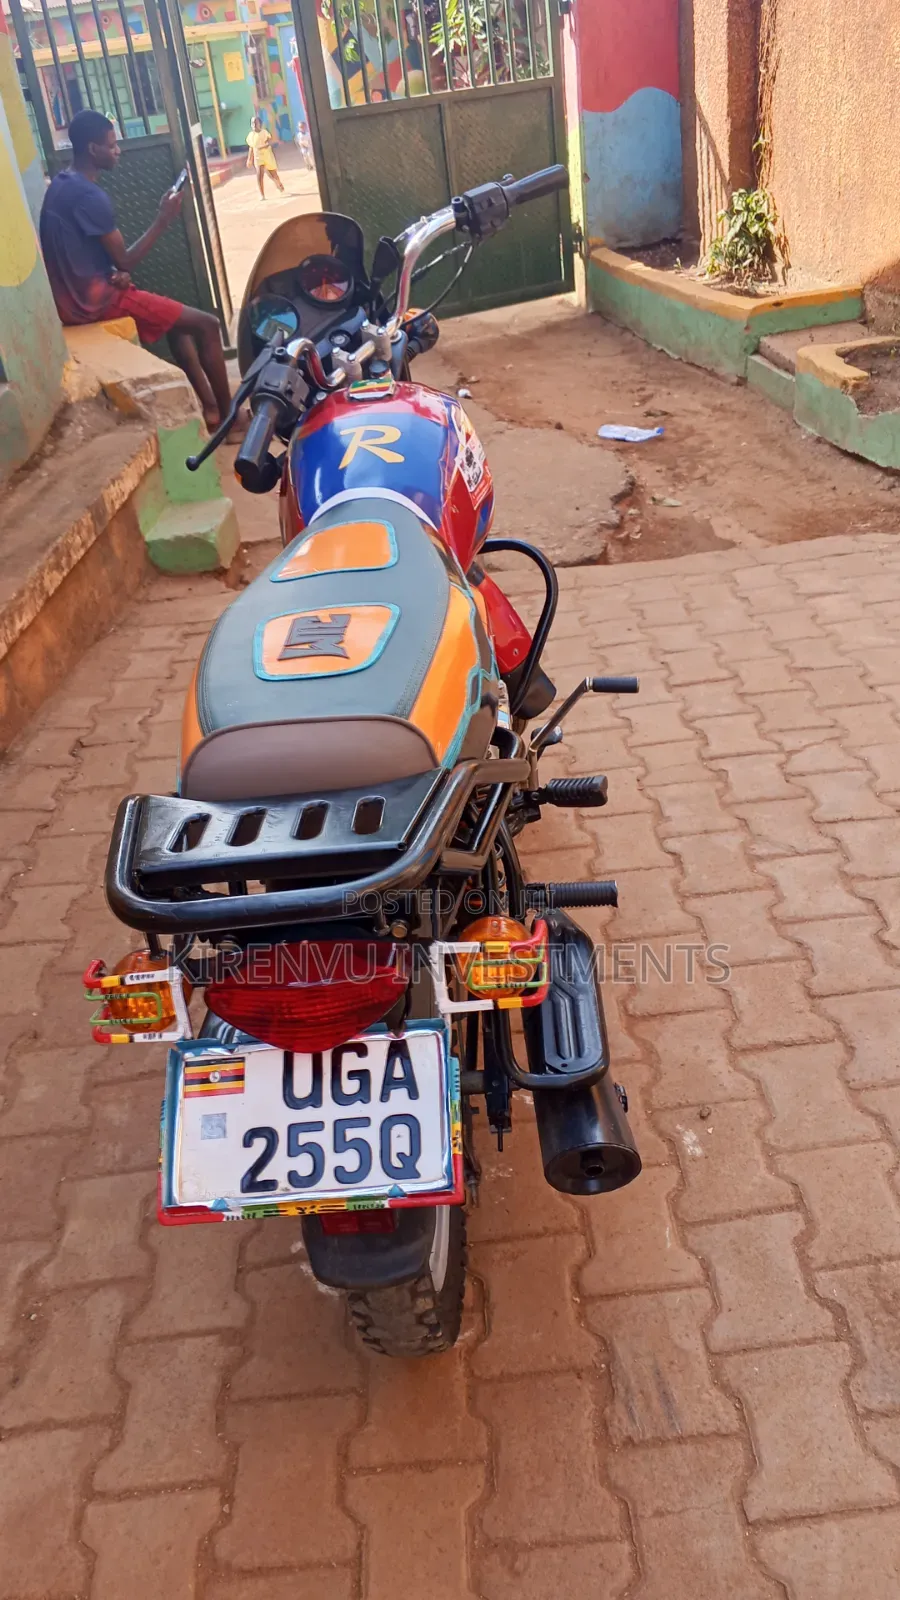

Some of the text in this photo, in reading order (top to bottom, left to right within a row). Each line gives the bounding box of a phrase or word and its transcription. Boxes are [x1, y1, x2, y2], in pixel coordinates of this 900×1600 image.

[338, 424, 405, 470] R
[282, 1039, 419, 1110] UGA
[240, 1113, 422, 1194] 255Q
